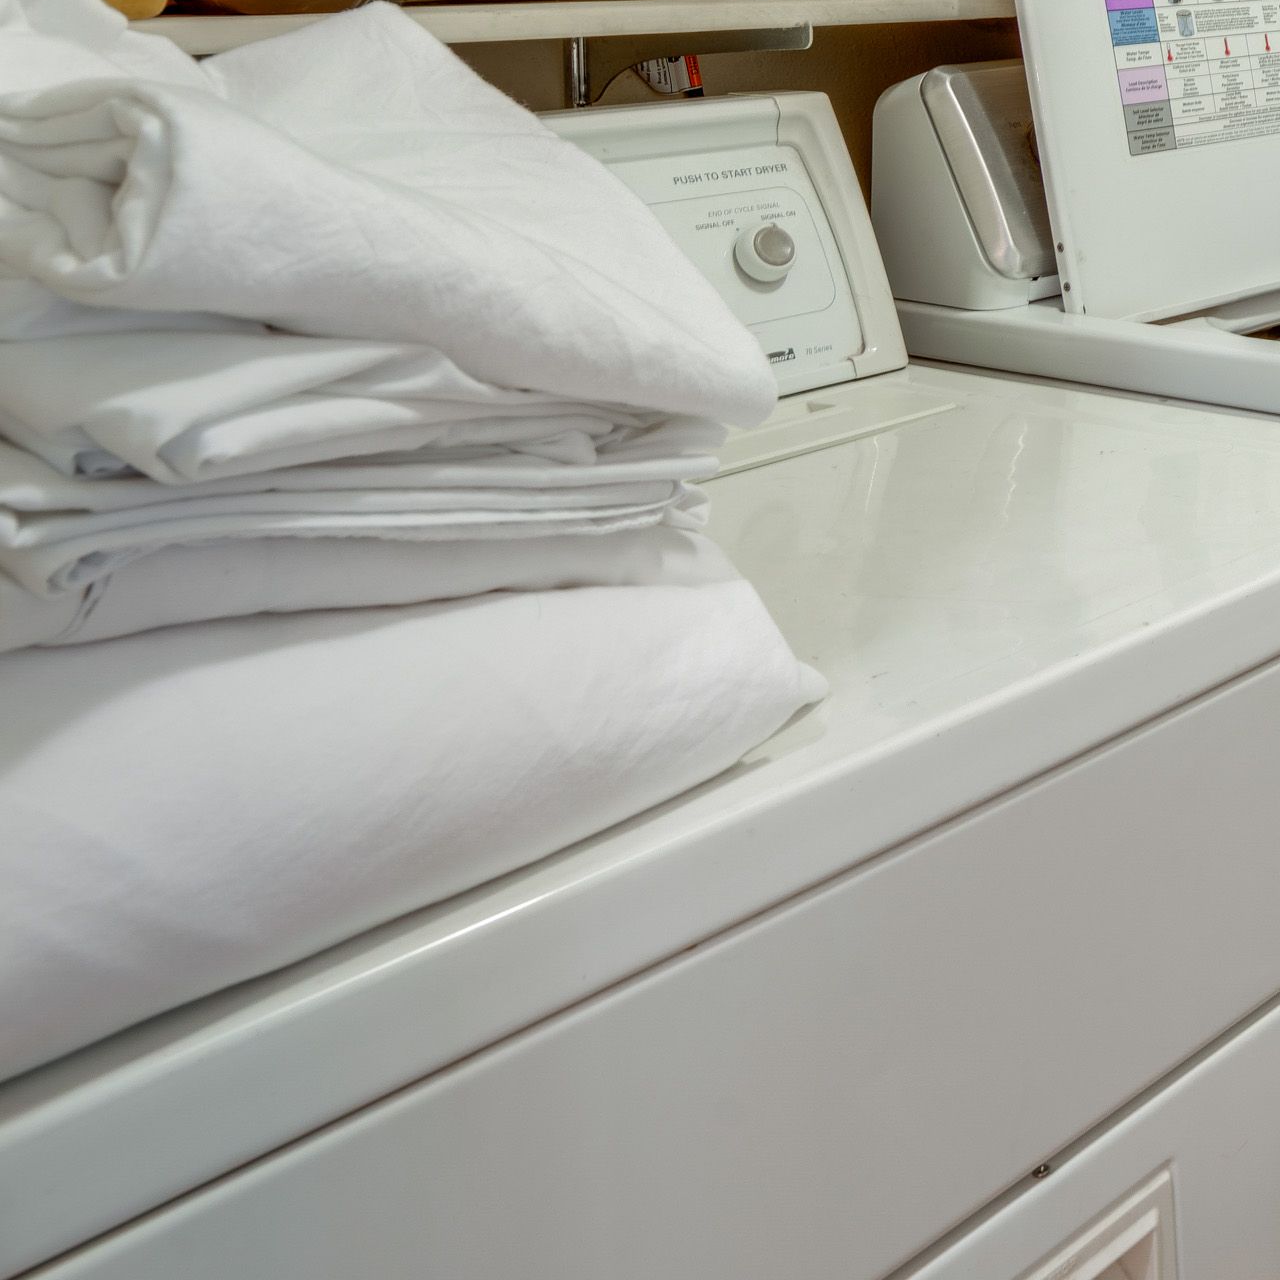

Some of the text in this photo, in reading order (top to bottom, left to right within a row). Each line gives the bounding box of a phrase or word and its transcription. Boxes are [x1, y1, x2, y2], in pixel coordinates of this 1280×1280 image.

[673, 162, 788, 186] PUSH TO START DRYER
[707, 201, 781, 218] END OF CYCLE SIGNAL
[760, 209, 796, 222] SIGNAL ON
[695, 218, 735, 231] SIGNAL OFF
[813, 344, 833, 355] Series
